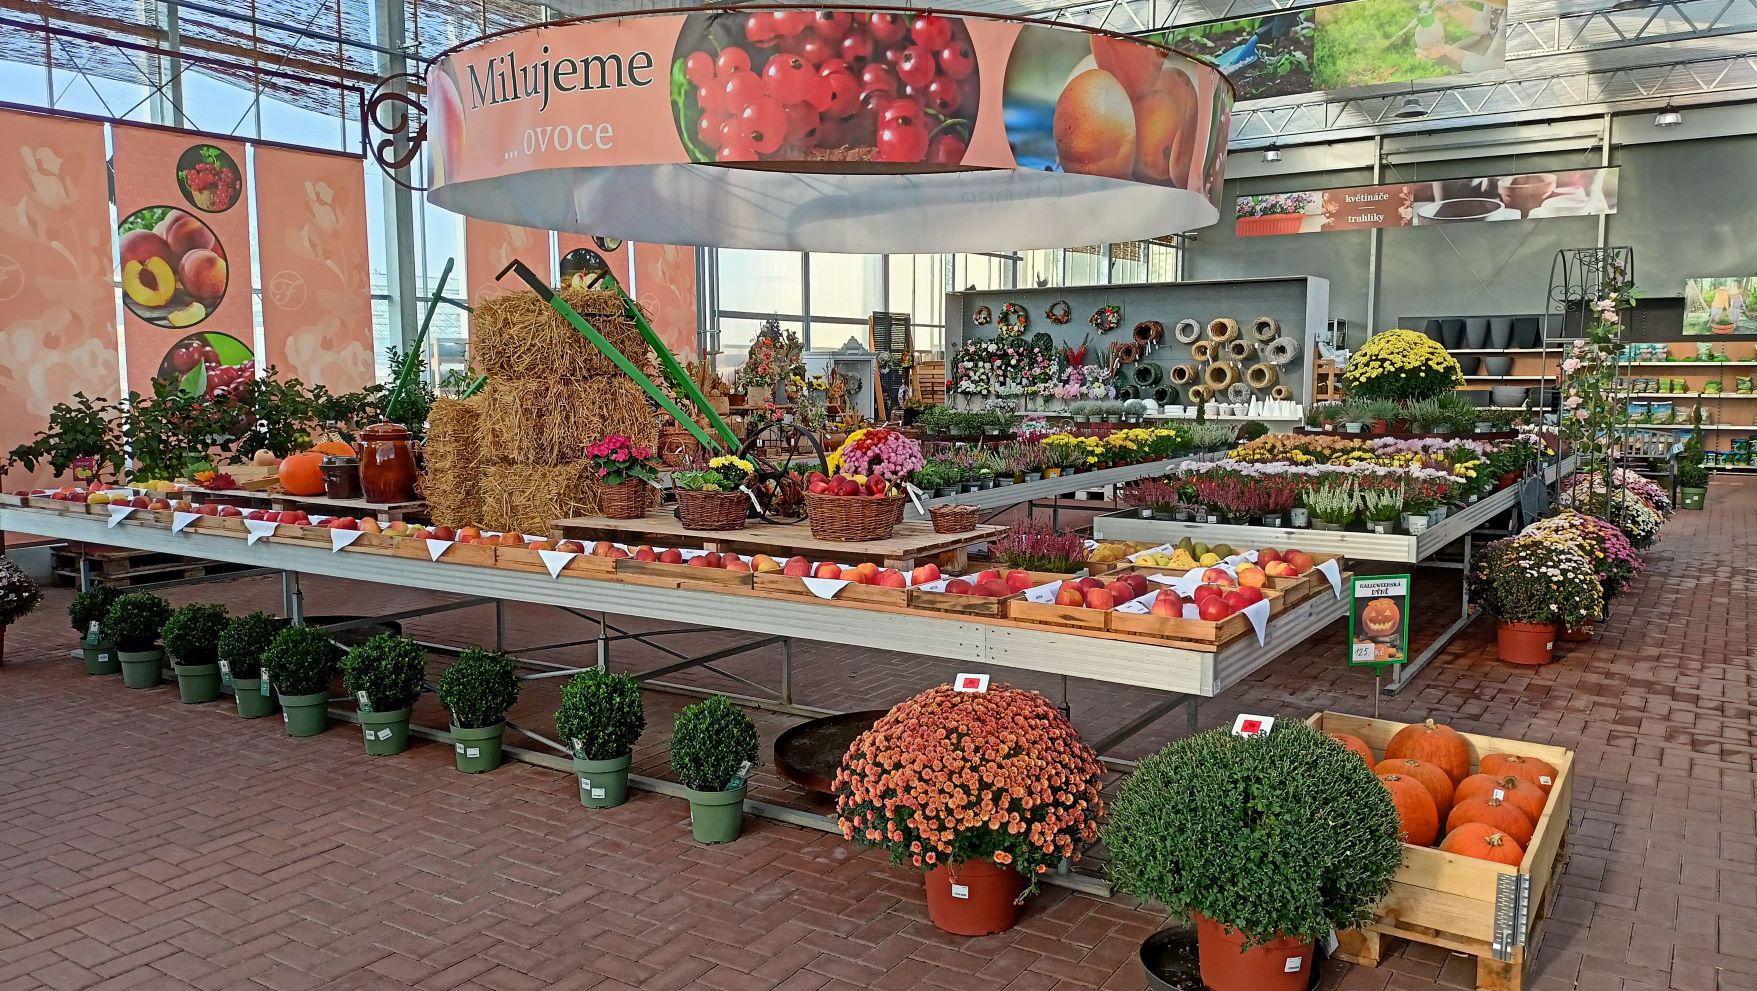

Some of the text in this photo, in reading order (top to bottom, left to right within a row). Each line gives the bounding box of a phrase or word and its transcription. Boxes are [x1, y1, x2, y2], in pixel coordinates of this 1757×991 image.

[467, 45, 654, 112] Milujeme
[523, 122, 613, 155] ovoce
[1345, 192, 1389, 203] květináče
[1347, 213, 1385, 223] truhlíky
